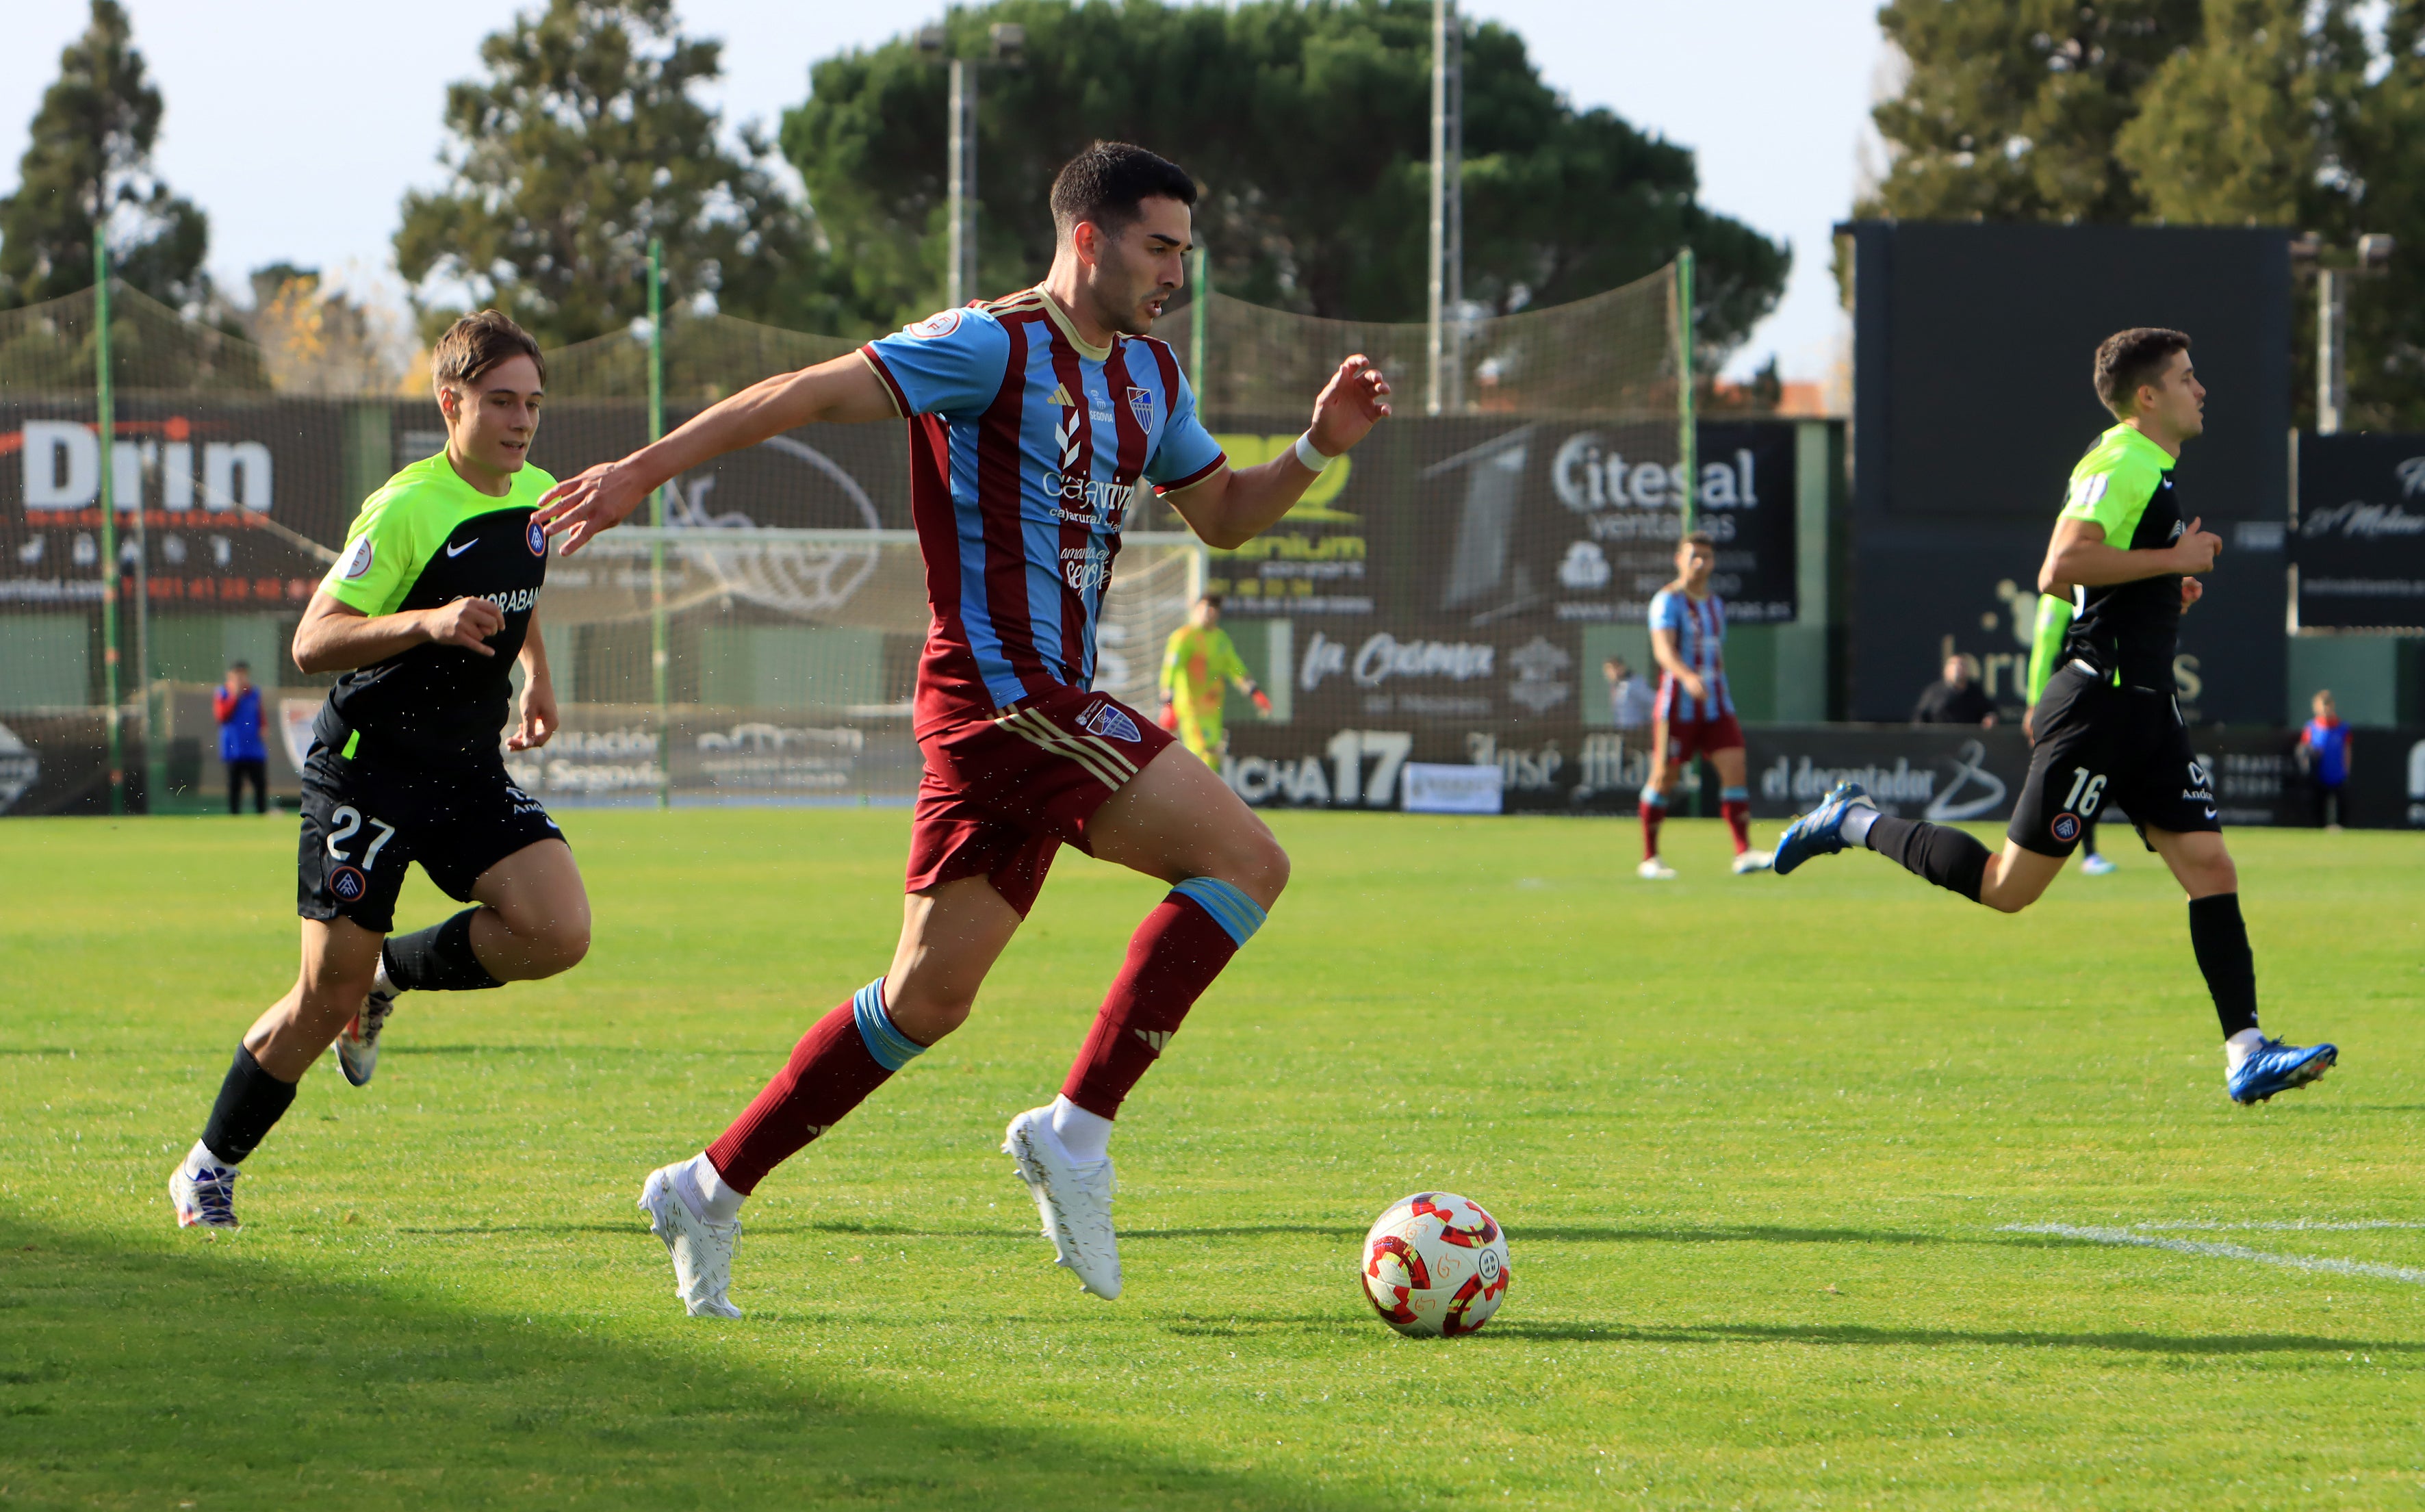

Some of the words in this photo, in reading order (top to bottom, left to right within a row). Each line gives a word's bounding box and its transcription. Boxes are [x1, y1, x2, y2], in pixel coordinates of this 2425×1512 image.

[1090, 410, 1114, 423] SEGOVIA
[23, 419, 272, 511] Drin
[1552, 431, 1758, 511] Citesal
[1049, 508, 1102, 525] cajarural
[1587, 513, 1736, 541] ventaas
[1326, 729, 1412, 806] 17
[2064, 766, 2107, 816] 16
[326, 805, 396, 871] 27
